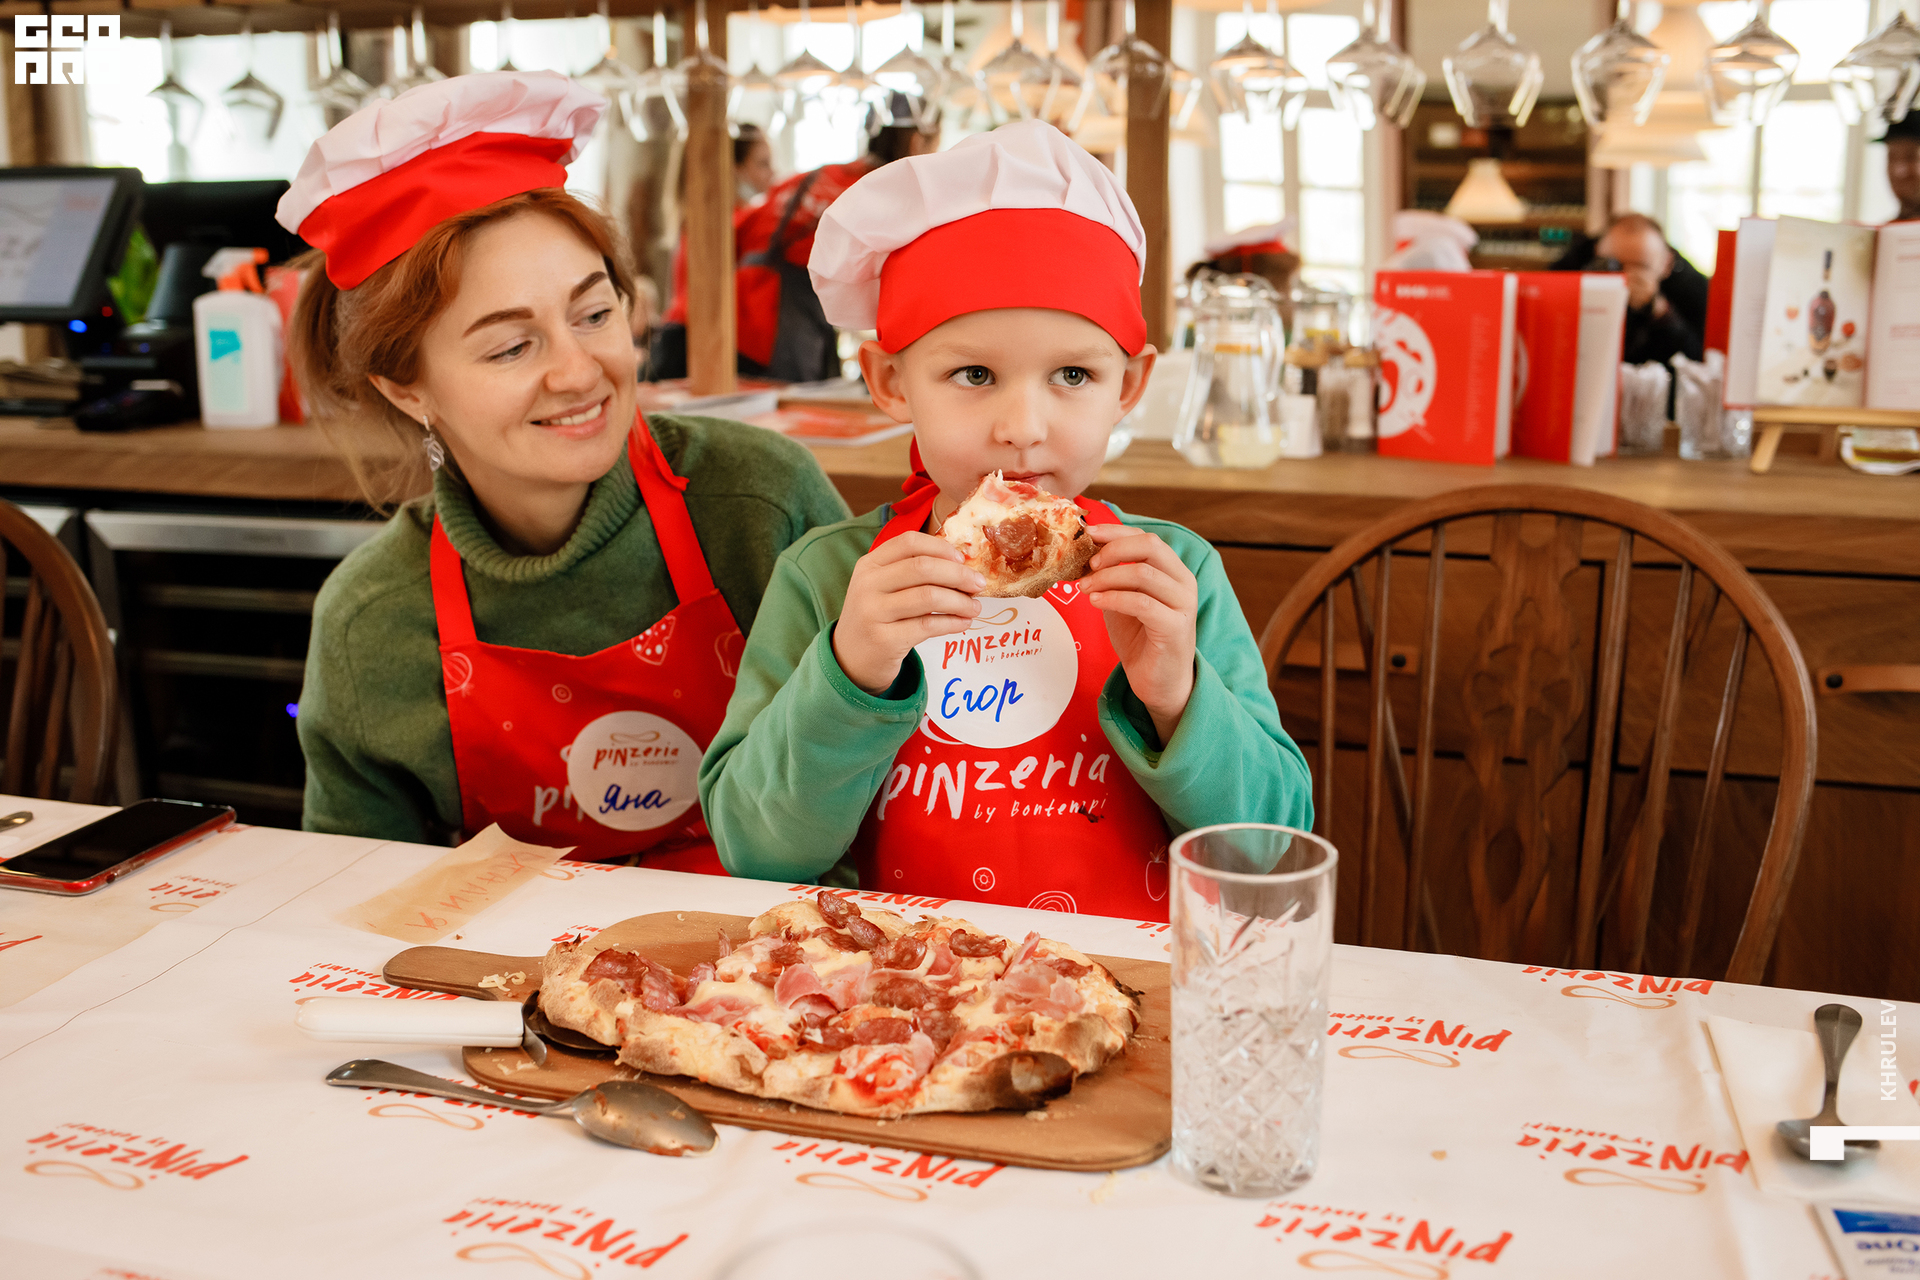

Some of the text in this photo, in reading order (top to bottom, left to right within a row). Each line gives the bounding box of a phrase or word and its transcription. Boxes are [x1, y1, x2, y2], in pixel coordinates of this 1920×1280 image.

[985, 655, 995, 663] by
[941, 677, 1024, 723] Егор
[599, 784, 672, 814] Яна
[974, 804, 997, 823] by
[1404, 1015, 1425, 1025] by
[1327, 1020, 1513, 1056] piNzeri
